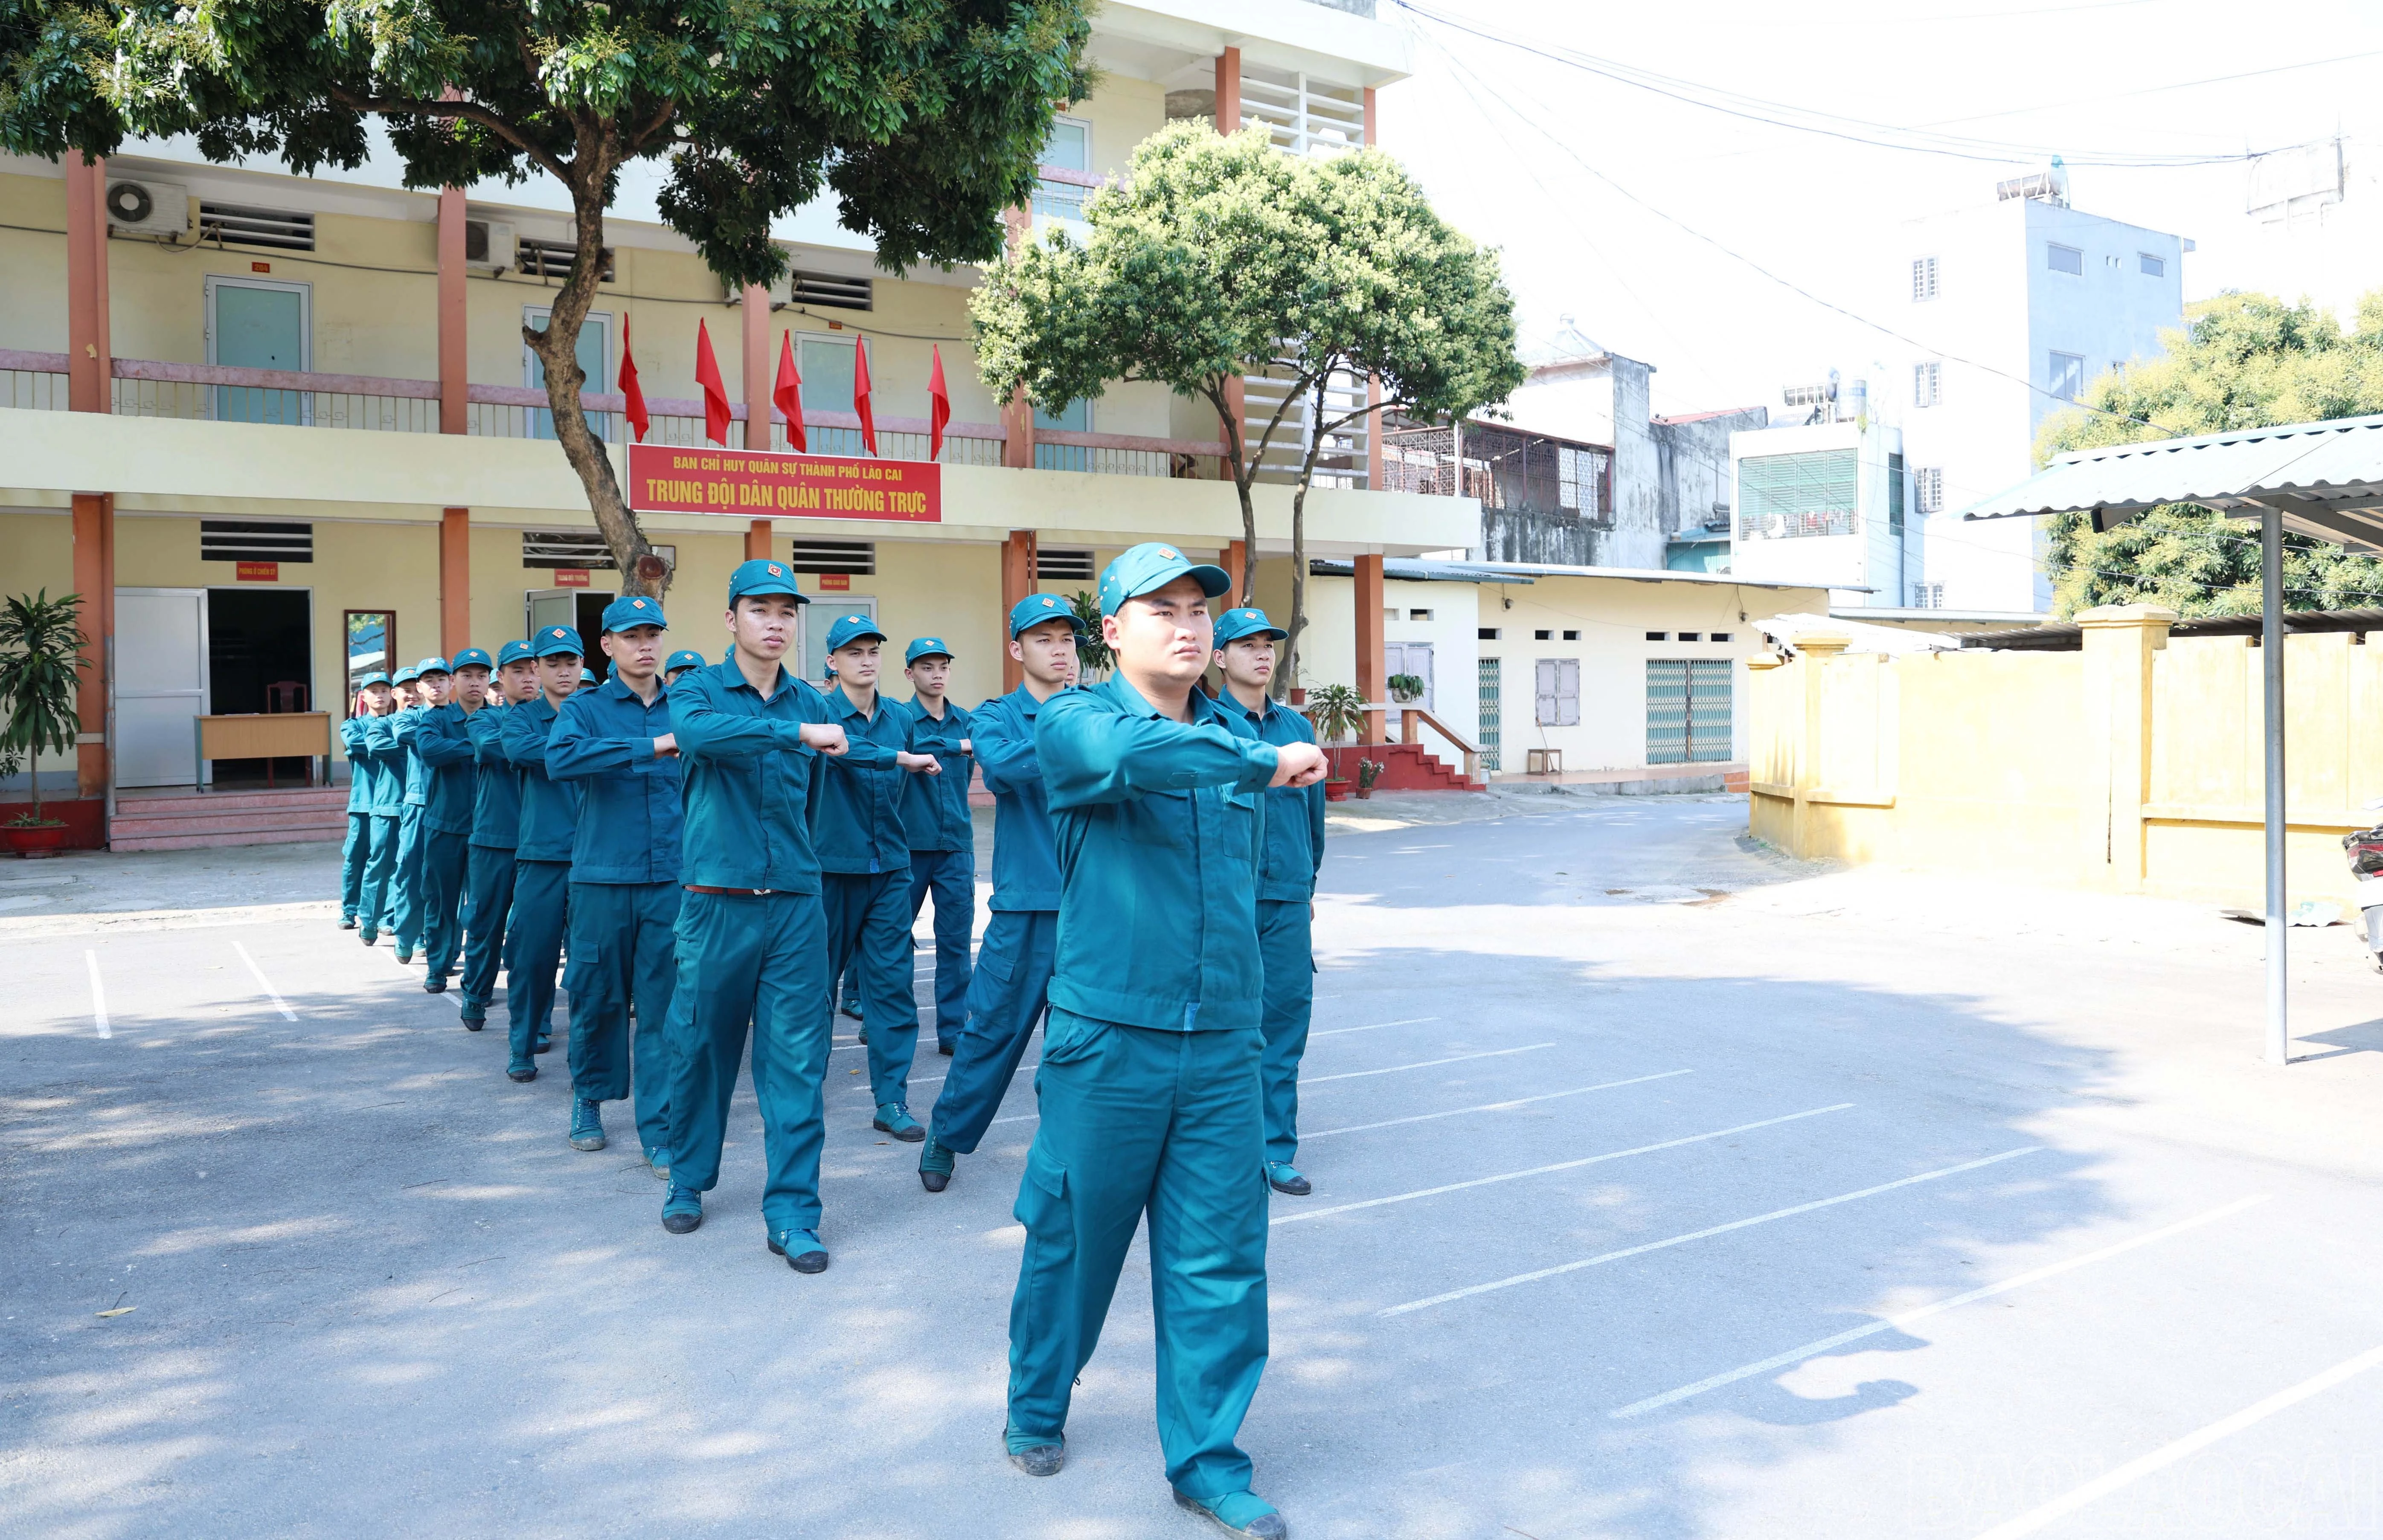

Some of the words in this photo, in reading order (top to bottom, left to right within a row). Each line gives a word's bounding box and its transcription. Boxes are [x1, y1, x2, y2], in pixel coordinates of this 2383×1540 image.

[673, 456, 697, 470] BAN
[701, 454, 720, 471] CHỈ
[724, 459, 745, 472] HUY
[748, 458, 779, 474] QUÂN
[782, 461, 798, 478] SỰ
[799, 461, 835, 477] THÀNH
[838, 464, 860, 479] PHỐ
[862, 465, 882, 480] LÀO
[885, 468, 902, 481] CAI
[646, 479, 703, 504] TRUNG
[707, 477, 735, 510] ĐỘI
[740, 479, 773, 507] DÂN
[777, 482, 820, 510] QUÂN
[824, 484, 884, 512] THƯỜNG
[889, 491, 927, 518] TRỰC
